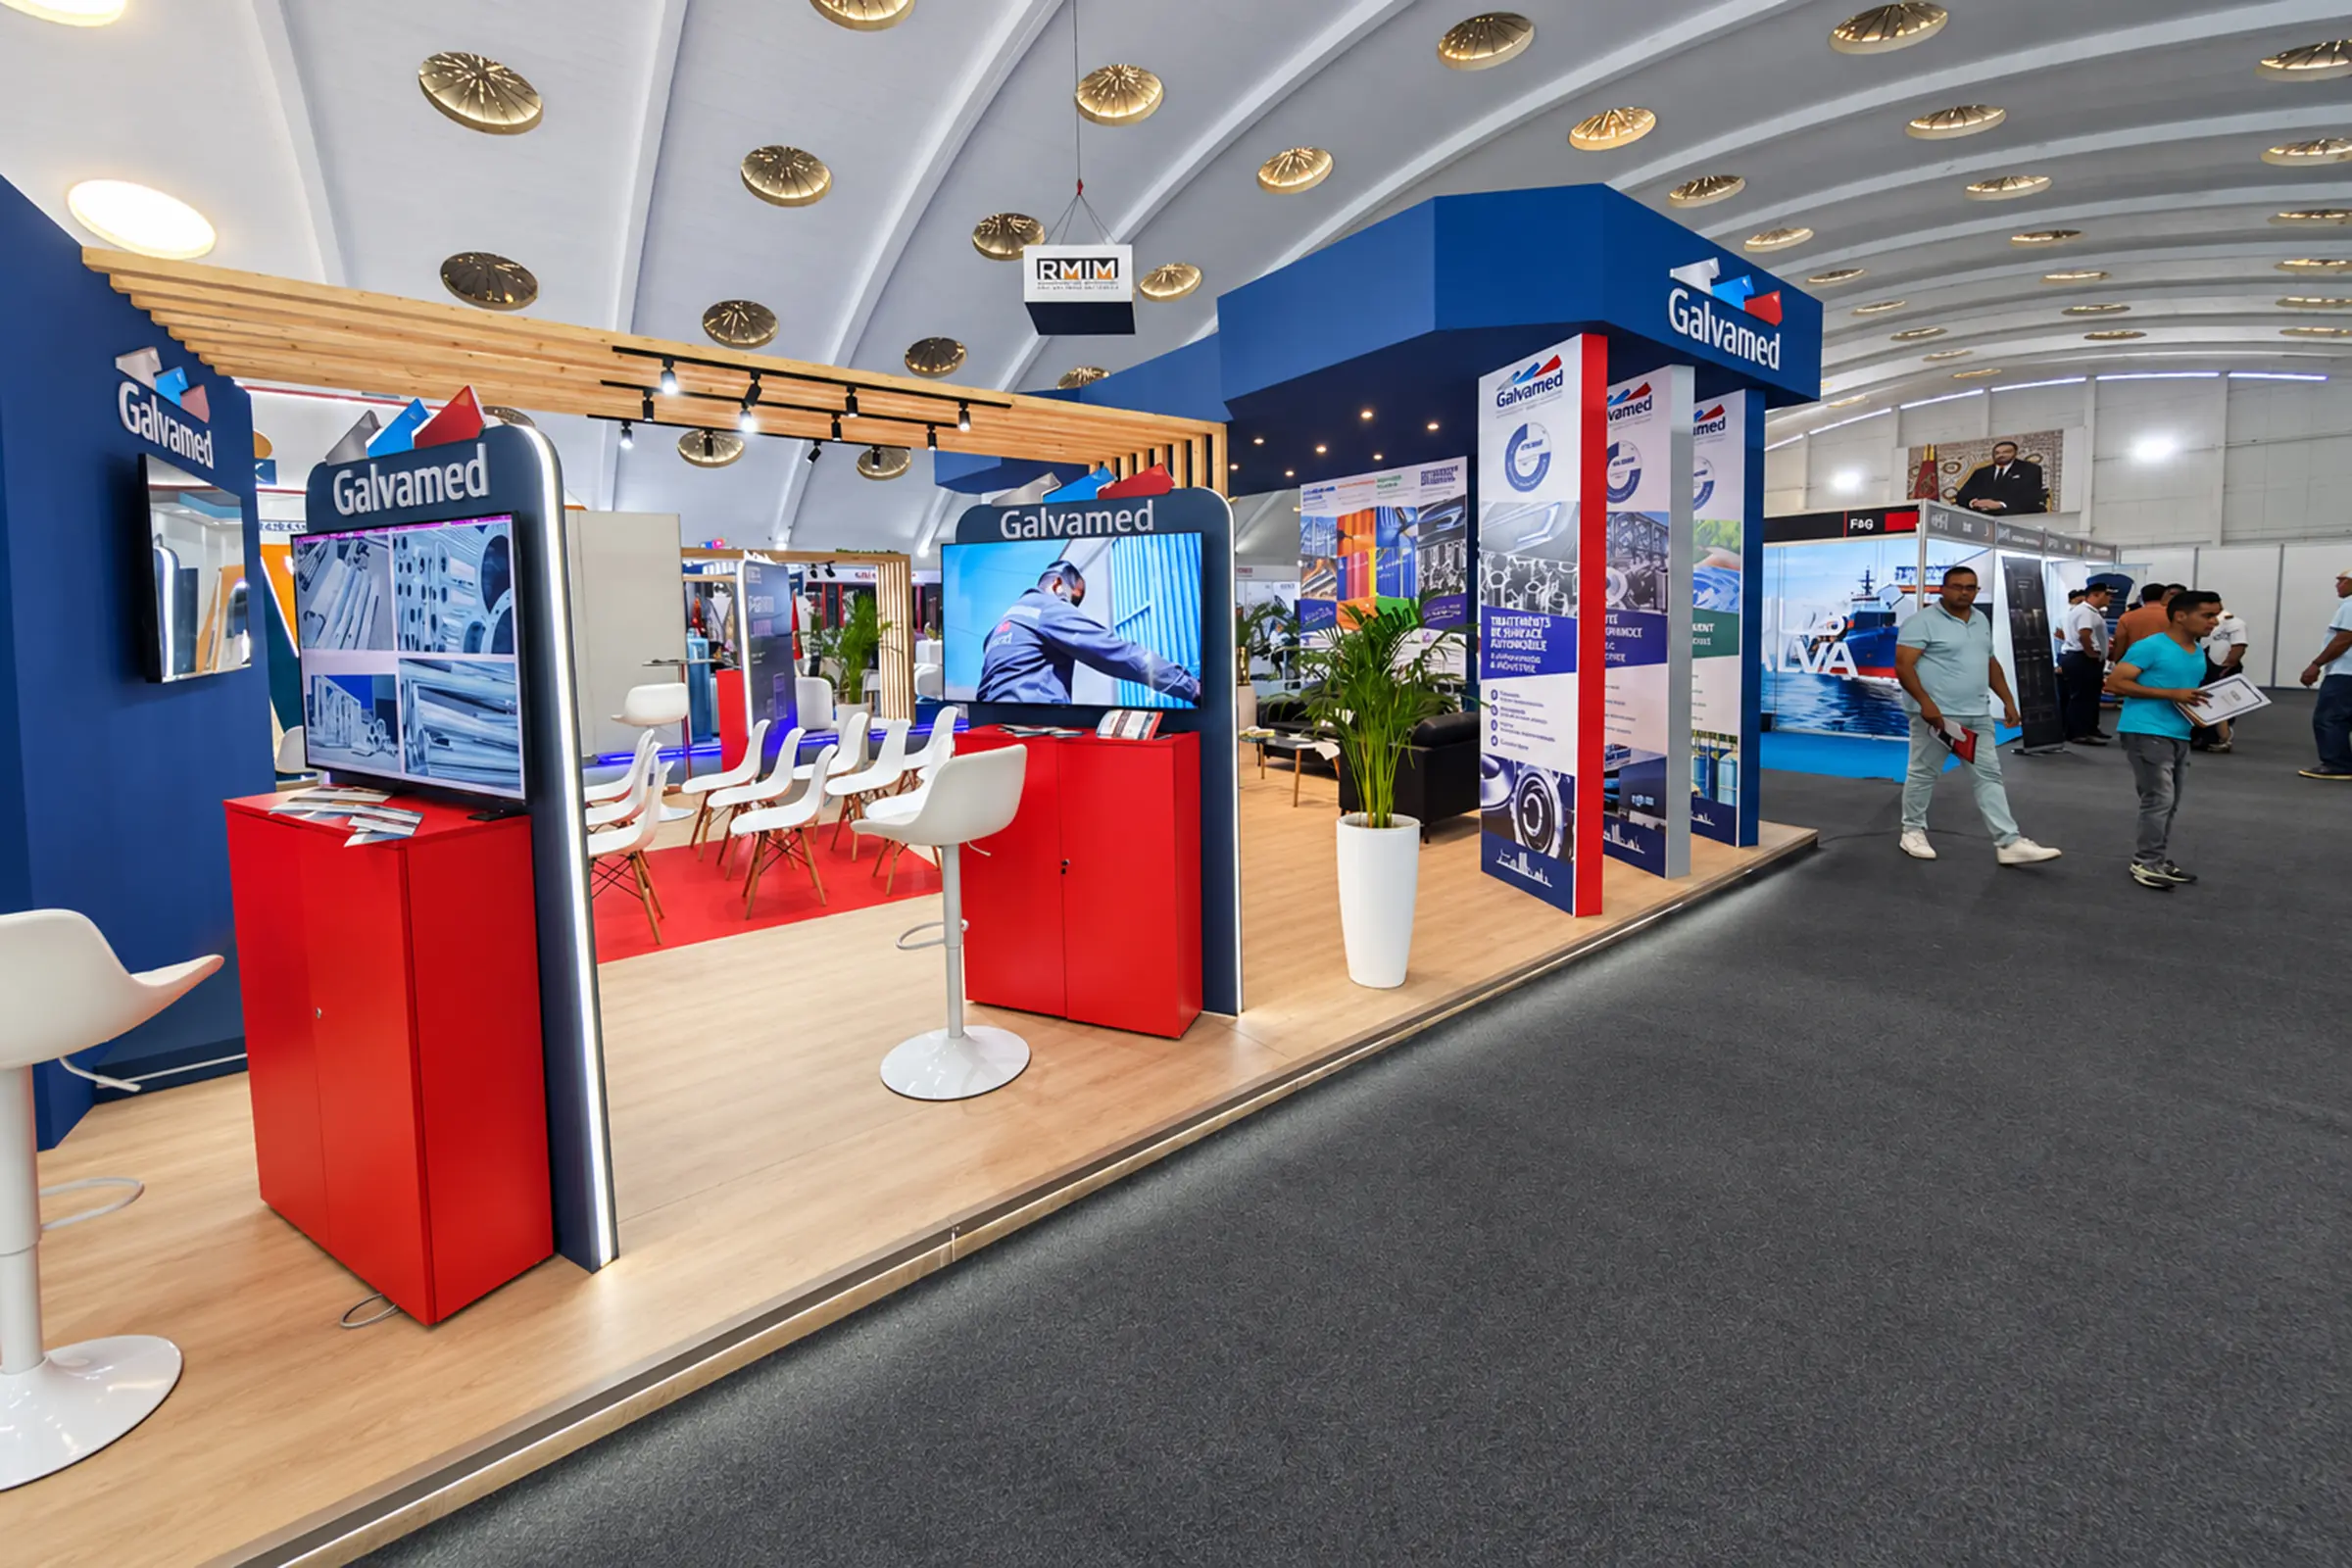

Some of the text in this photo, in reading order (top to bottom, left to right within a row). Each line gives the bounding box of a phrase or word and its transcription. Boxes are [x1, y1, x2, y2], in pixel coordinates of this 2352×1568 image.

[1669, 288, 1781, 371] Galvamed
[1496, 369, 1563, 408] Galvamed
[1608, 395, 1652, 421] vamed
[119, 380, 214, 469] Galvamed
[333, 443, 489, 515] Galvamed
[1000, 499, 1154, 539] Galvamed
